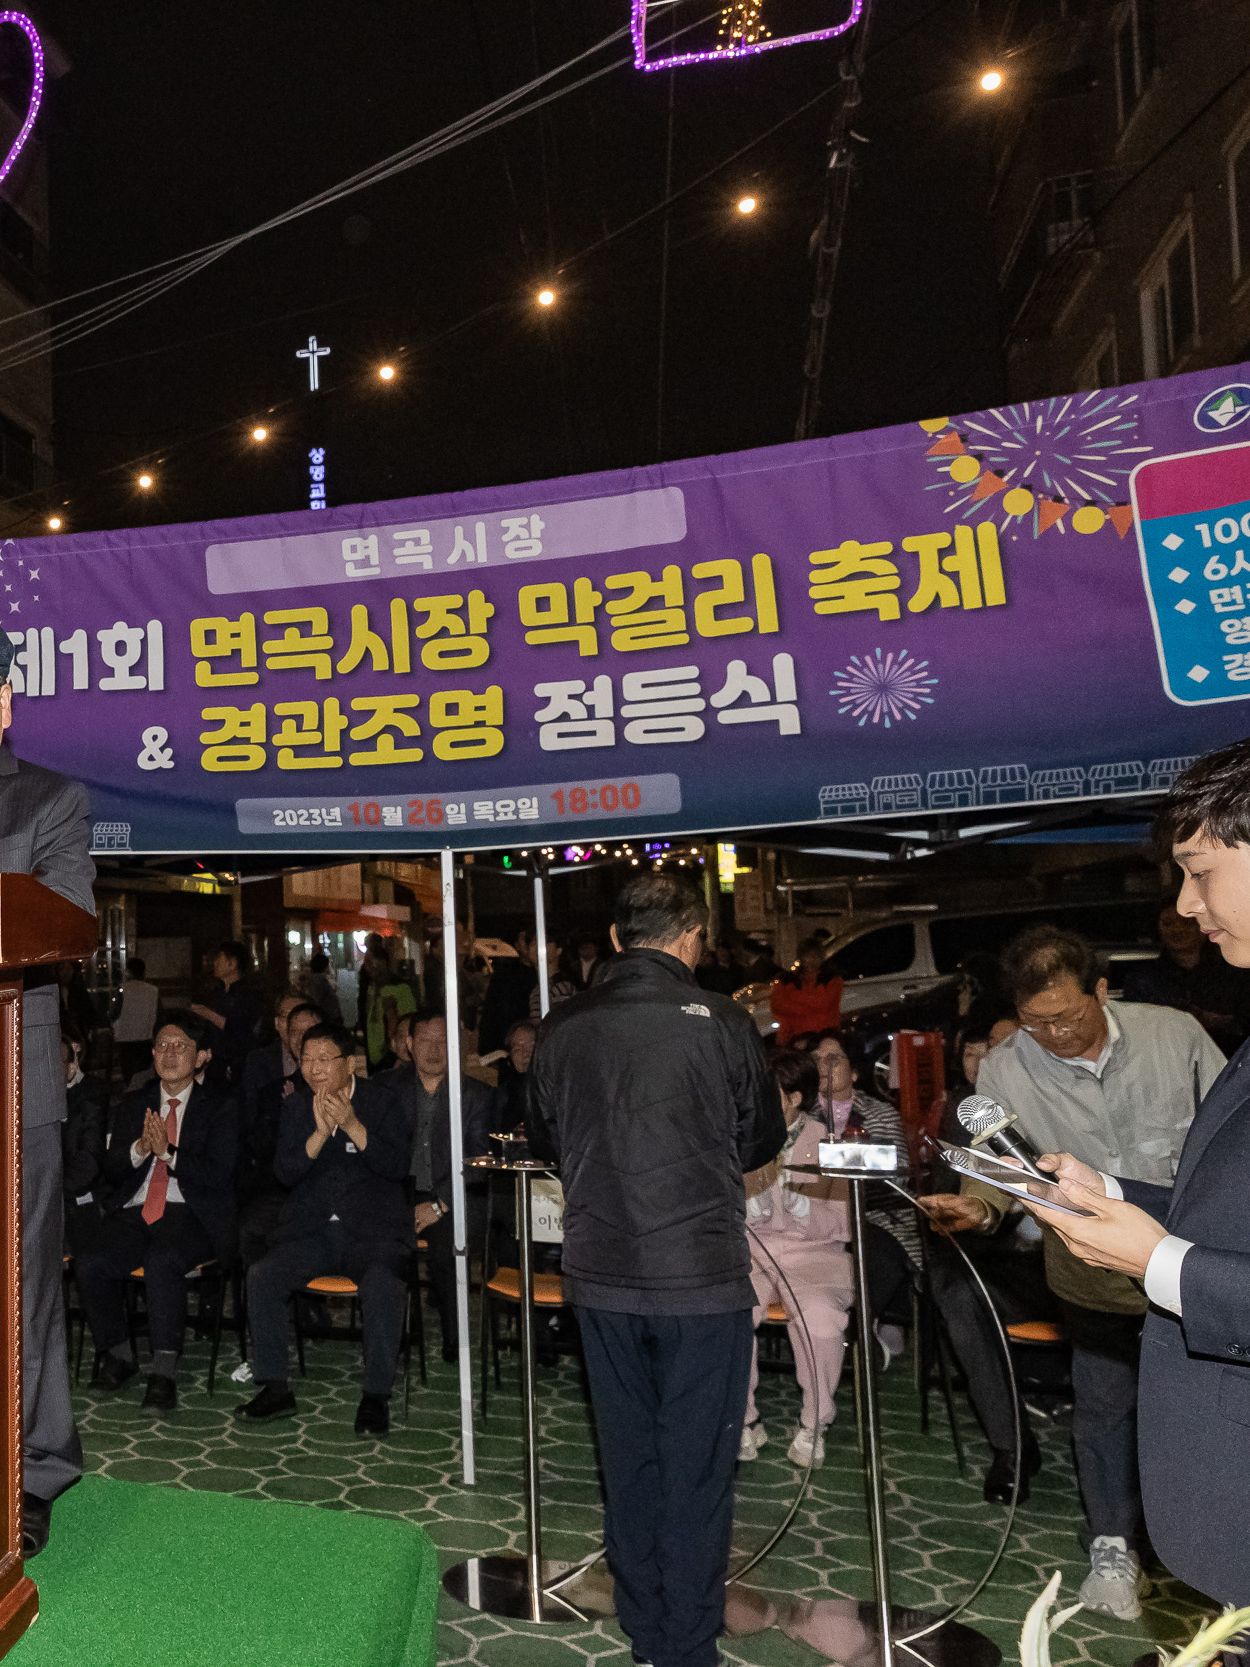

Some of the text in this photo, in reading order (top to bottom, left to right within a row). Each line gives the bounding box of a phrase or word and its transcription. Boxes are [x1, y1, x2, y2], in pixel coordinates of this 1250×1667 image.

[341, 513, 546, 578] 면곡시장
[6, 520, 1007, 697] 제1회 면곡시장 막걸리 축제
[1209, 584, 1250, 613] 면
[136, 652, 802, 772] & 경관조명 점등식
[272, 783, 642, 827] 2023년 10월 26일 목요일 18:00
